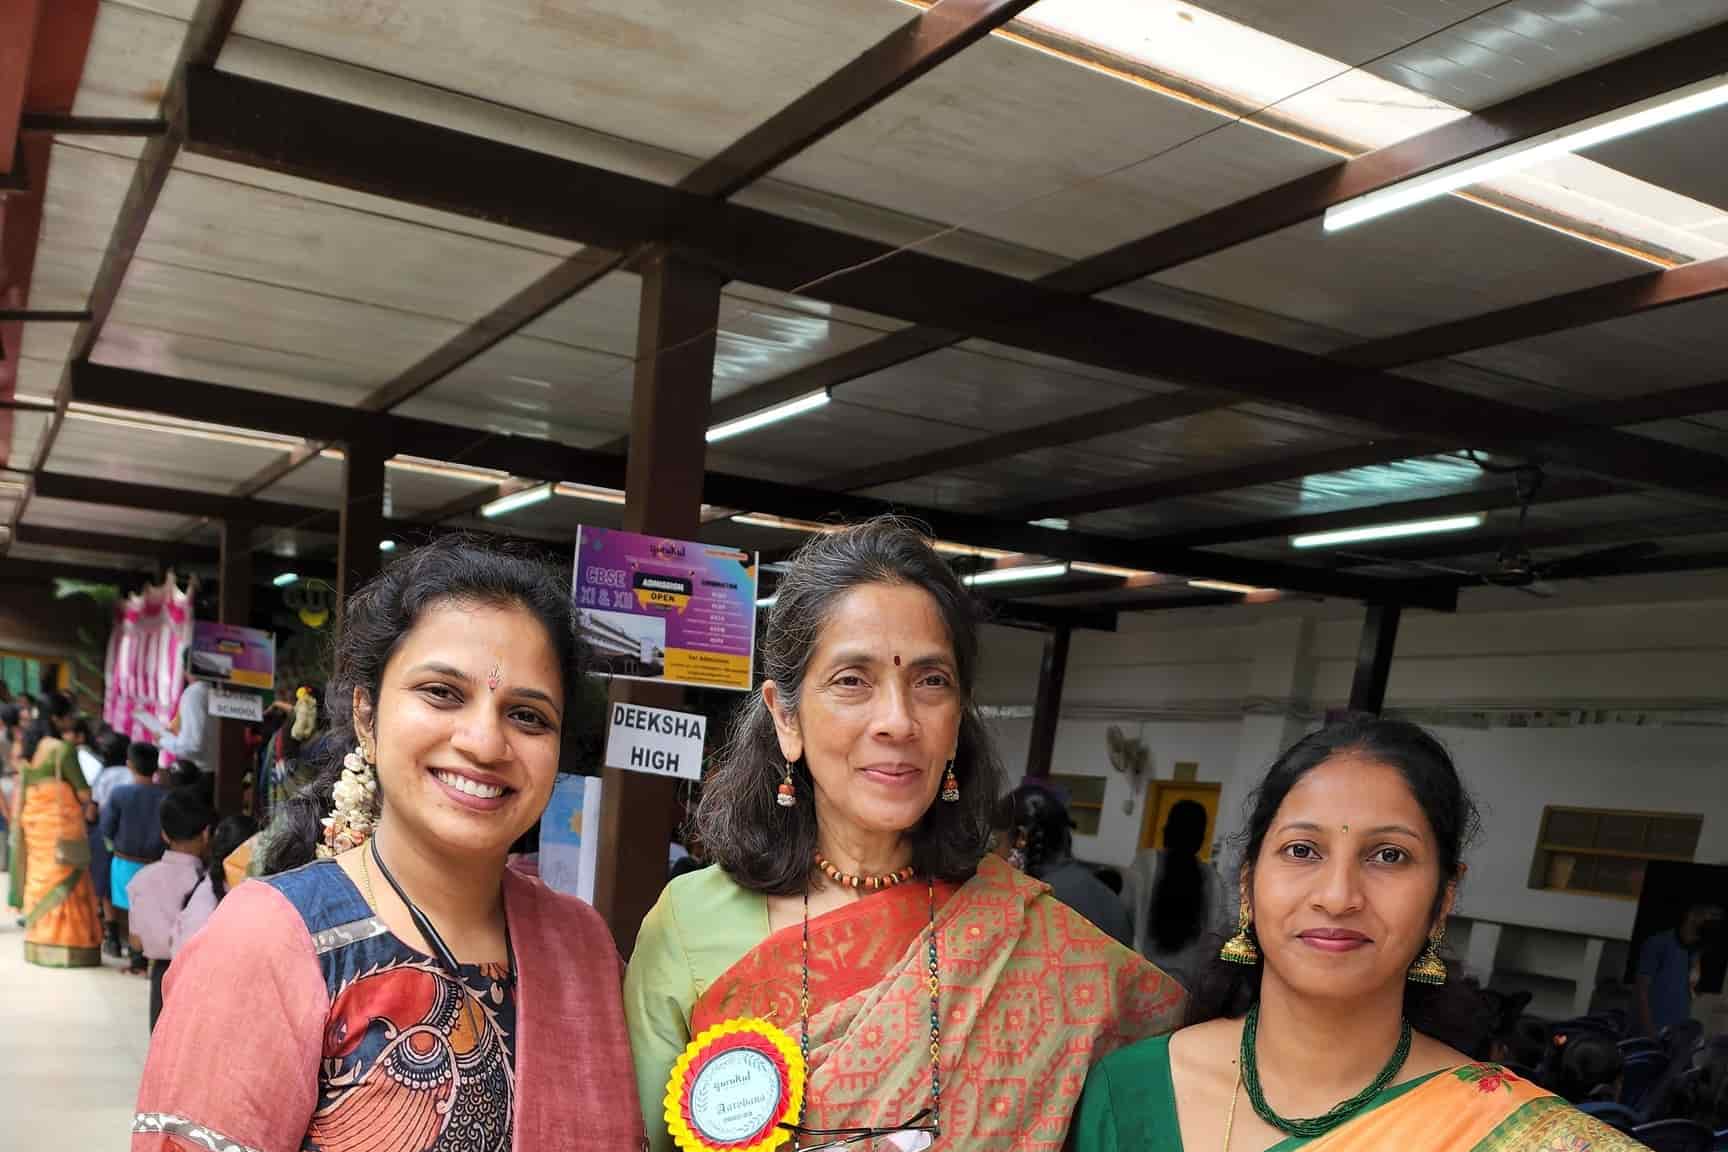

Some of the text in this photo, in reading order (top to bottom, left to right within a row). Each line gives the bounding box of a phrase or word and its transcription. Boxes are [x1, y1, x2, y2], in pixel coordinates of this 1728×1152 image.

[585, 567, 627, 588] CBSE
[650, 592, 676, 602] OPEN
[613, 705, 702, 740] DEEKSHA
[630, 745, 680, 772] HIGH
